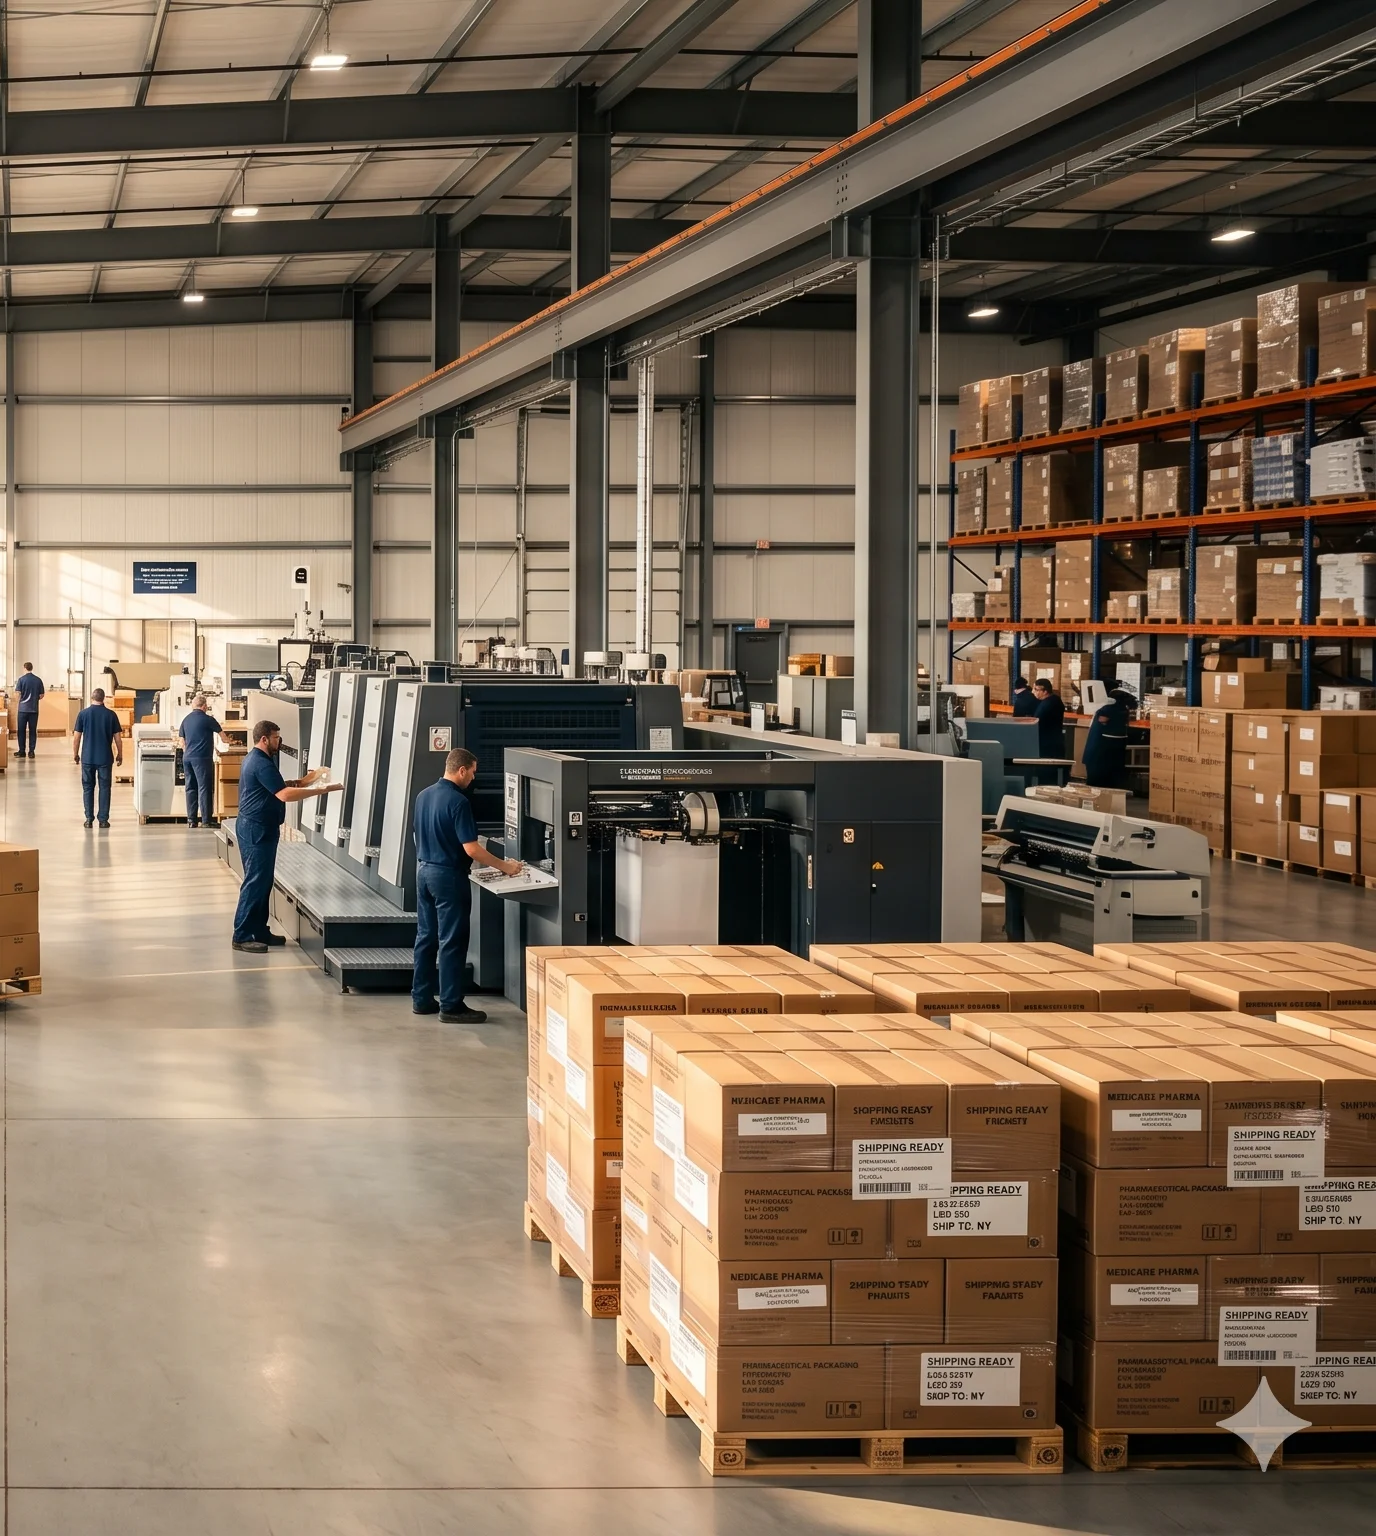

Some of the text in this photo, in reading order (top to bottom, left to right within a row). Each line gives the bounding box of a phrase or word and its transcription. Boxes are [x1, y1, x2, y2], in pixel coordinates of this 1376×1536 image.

[783, 1096, 826, 1105] PHARMA
[966, 1106, 1013, 1114] SHIPPING
[1233, 1130, 1317, 1140] SHIPPING READY
[858, 1142, 944, 1152] SHIPPING READY
[744, 1188, 815, 1196] PHARMACEUTICAL
[987, 1185, 1022, 1194] READY
[1304, 1216, 1327, 1225] SHIP
[1348, 1215, 1362, 1225] NY
[932, 1221, 955, 1231] SHIP
[977, 1221, 991, 1230] NY
[781, 1272, 824, 1281] PHARMA
[1106, 1268, 1200, 1276] MEDICARE PHARMA
[1225, 1311, 1309, 1320] SHIPPING READY
[927, 1357, 1014, 1366] SHIPPING READY
[1343, 1390, 1358, 1400] NY
